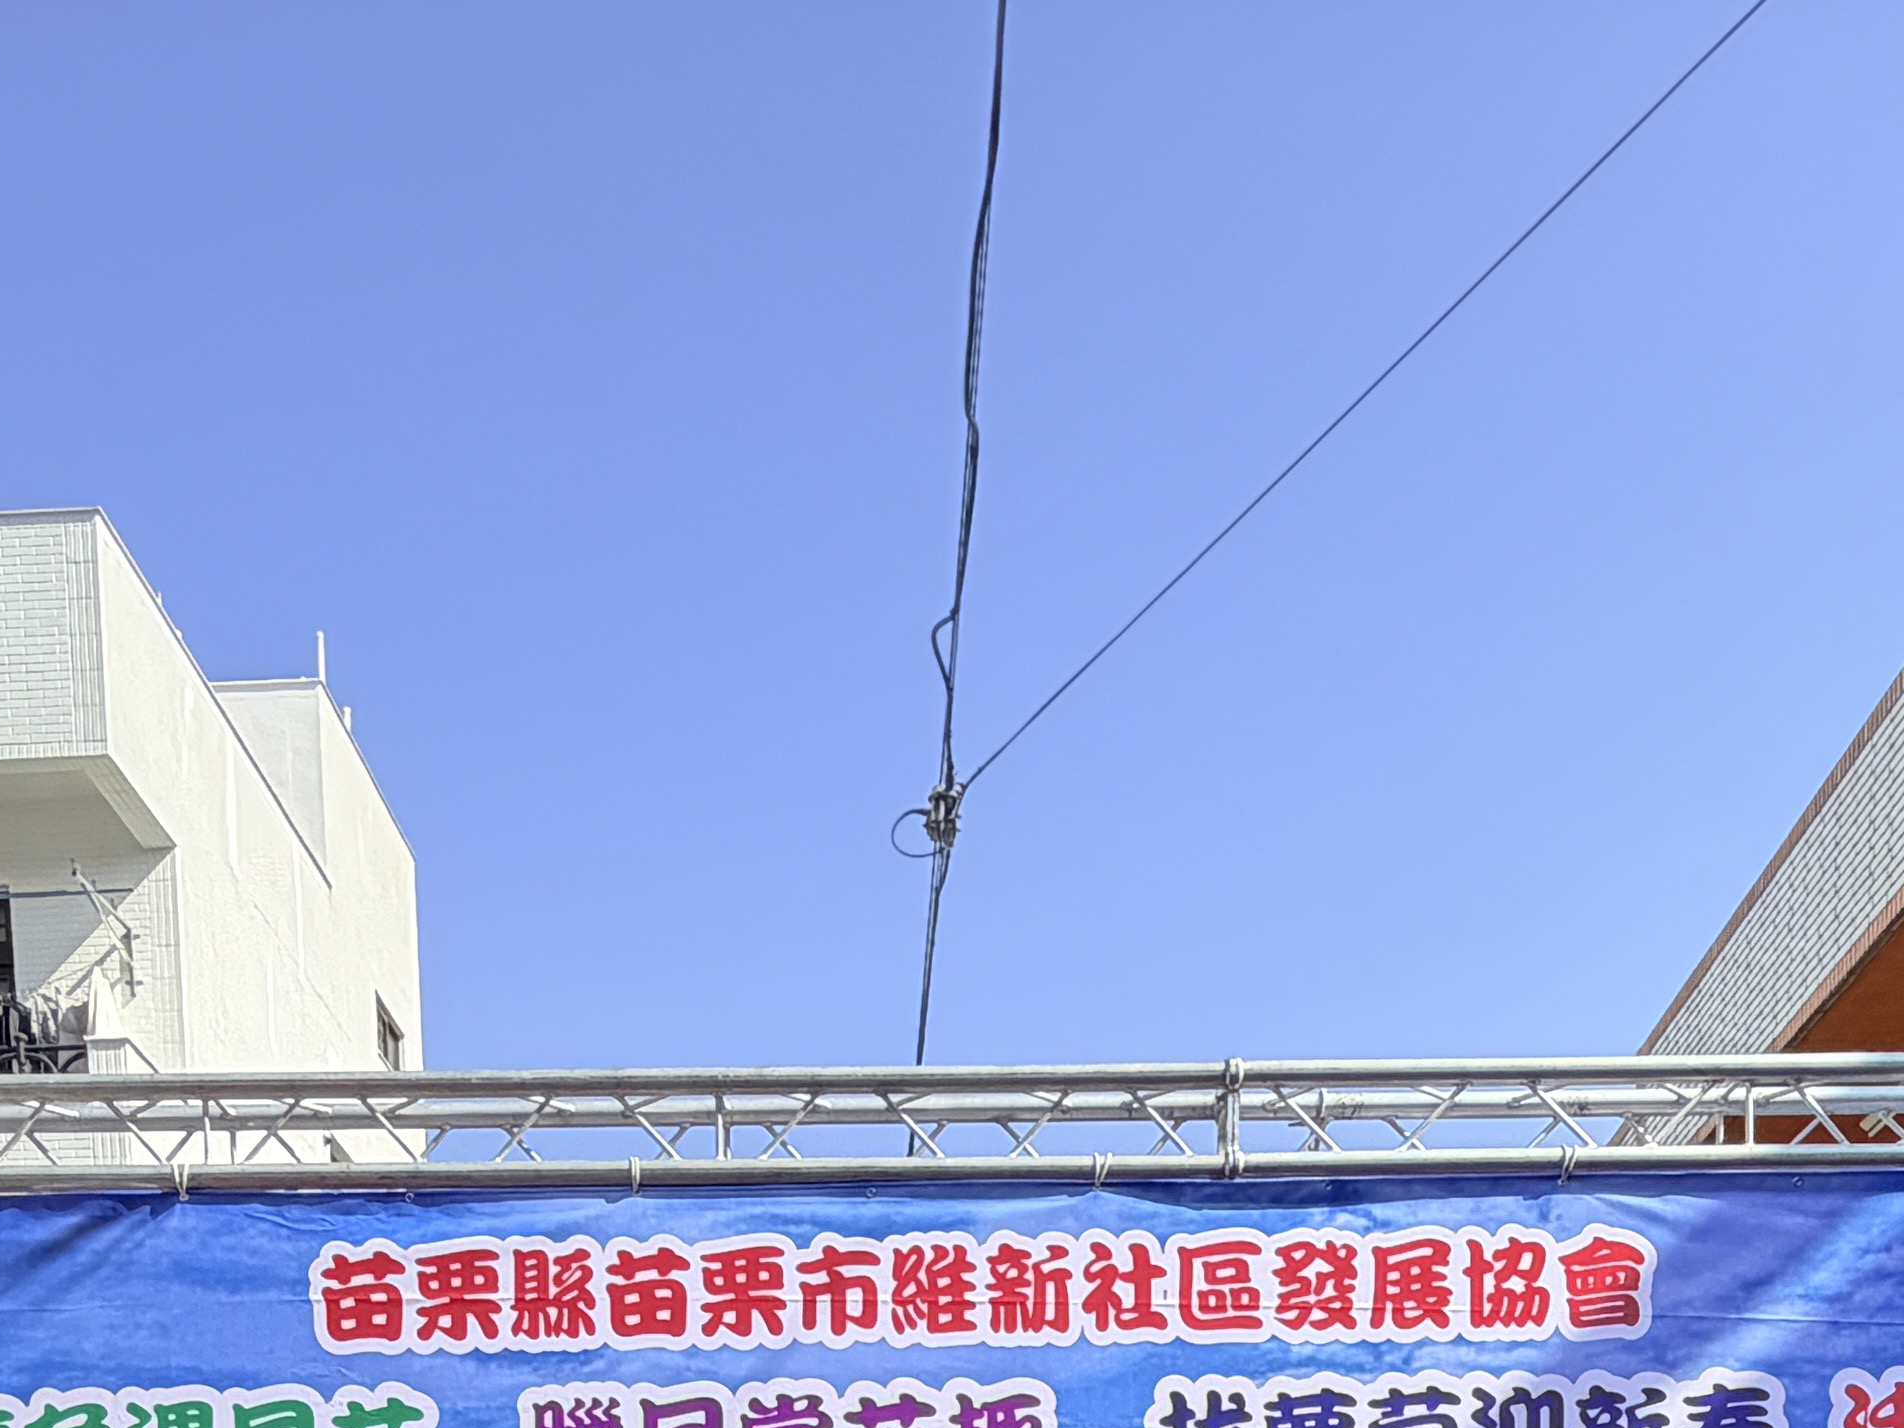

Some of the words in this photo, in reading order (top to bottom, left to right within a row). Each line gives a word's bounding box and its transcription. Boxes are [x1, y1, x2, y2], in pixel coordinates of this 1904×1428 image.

[318, 1236, 1650, 1345] 苗栗縣苗栗市維新社區發展協會
